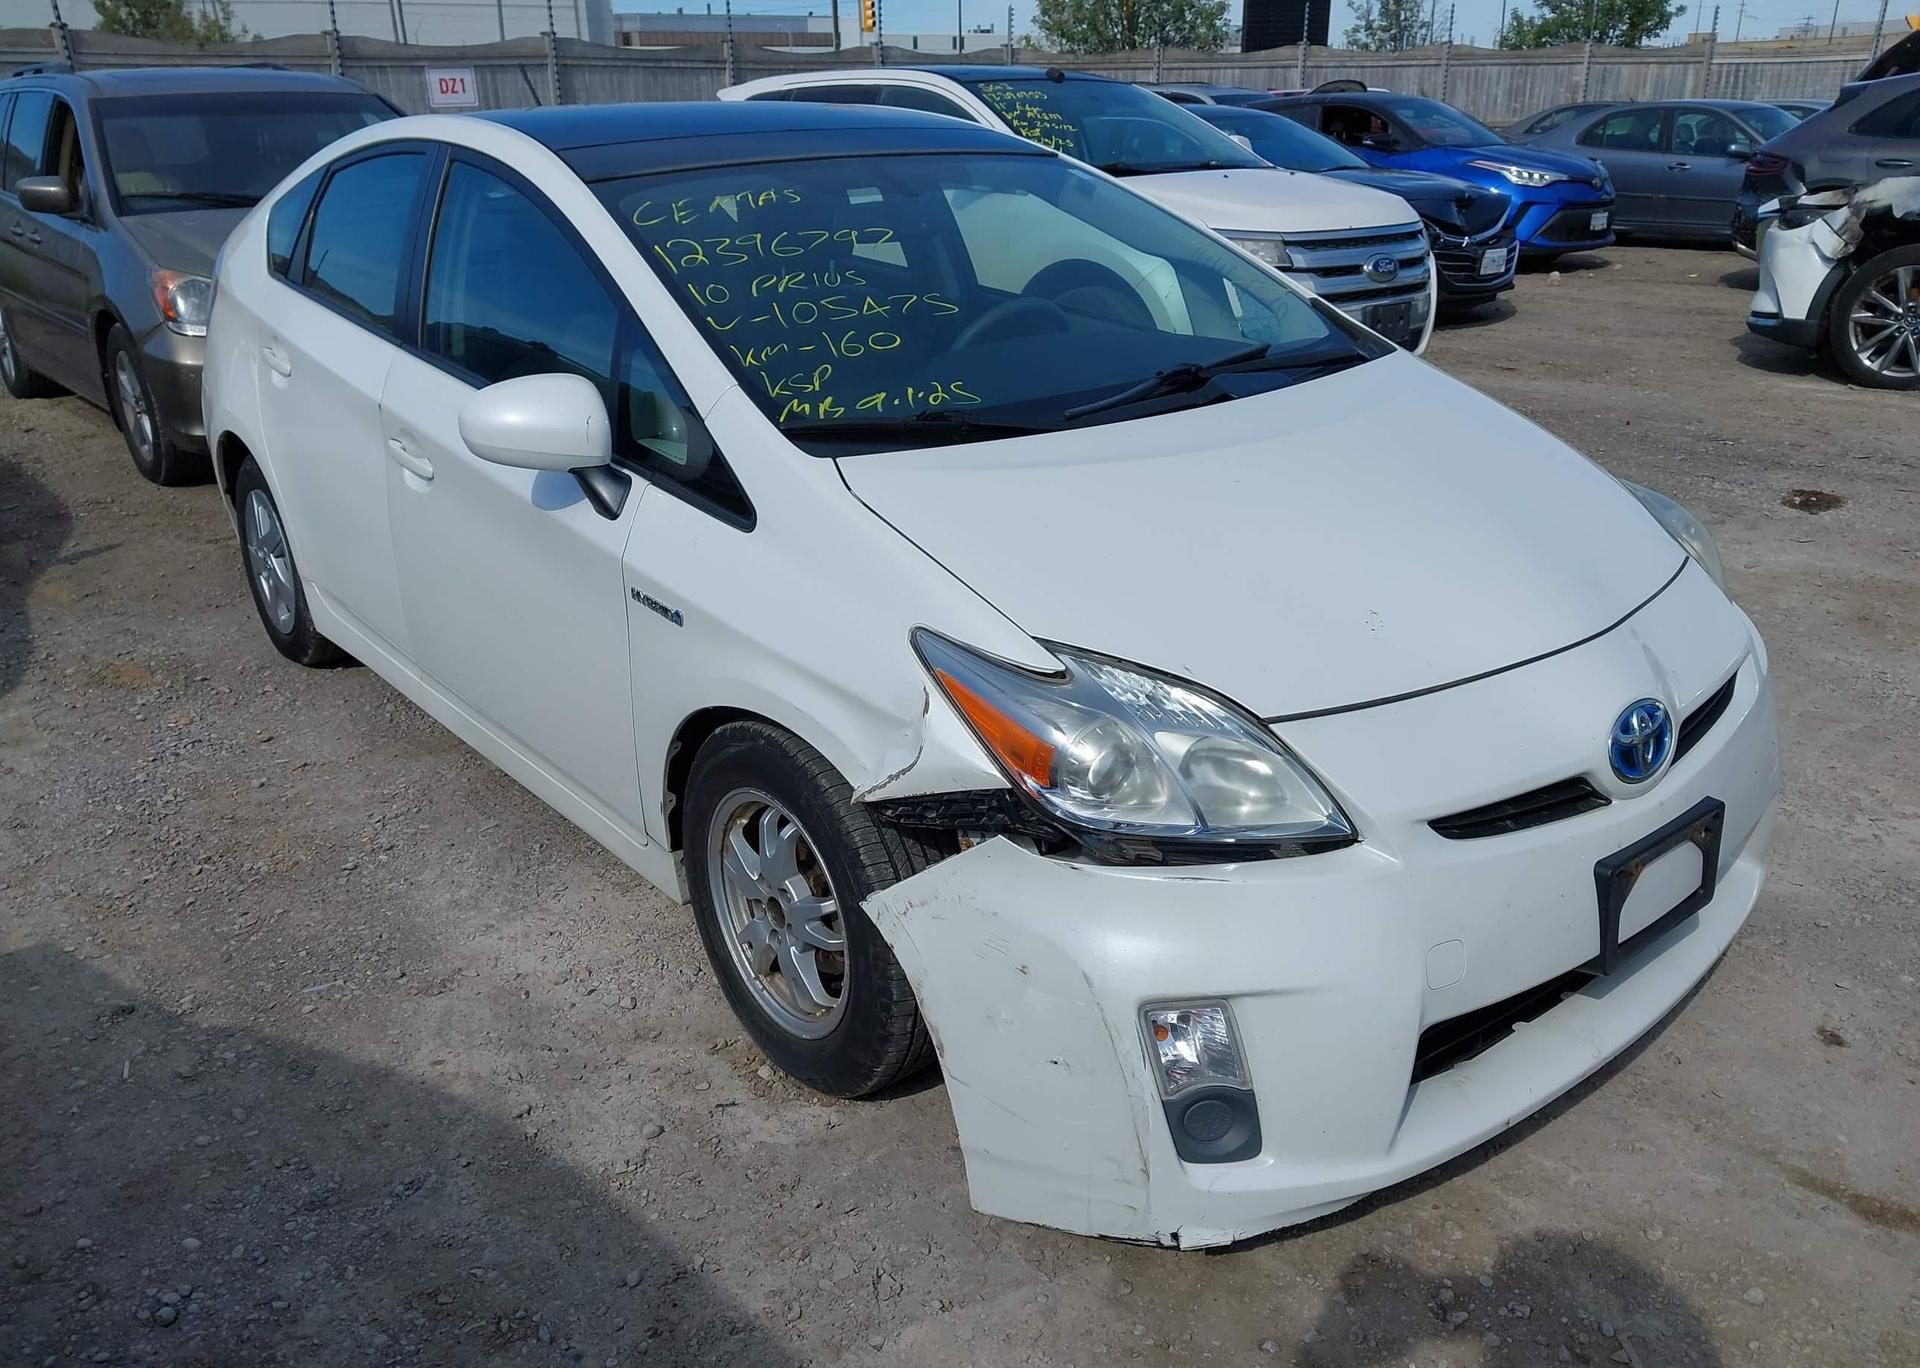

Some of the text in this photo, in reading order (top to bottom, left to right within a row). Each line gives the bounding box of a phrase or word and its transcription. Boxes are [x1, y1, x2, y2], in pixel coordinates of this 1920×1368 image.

[438, 78, 466, 94] DZ1
[1378, 258, 1396, 273] Ford
[687, 270, 866, 306] 10 PRIUS
